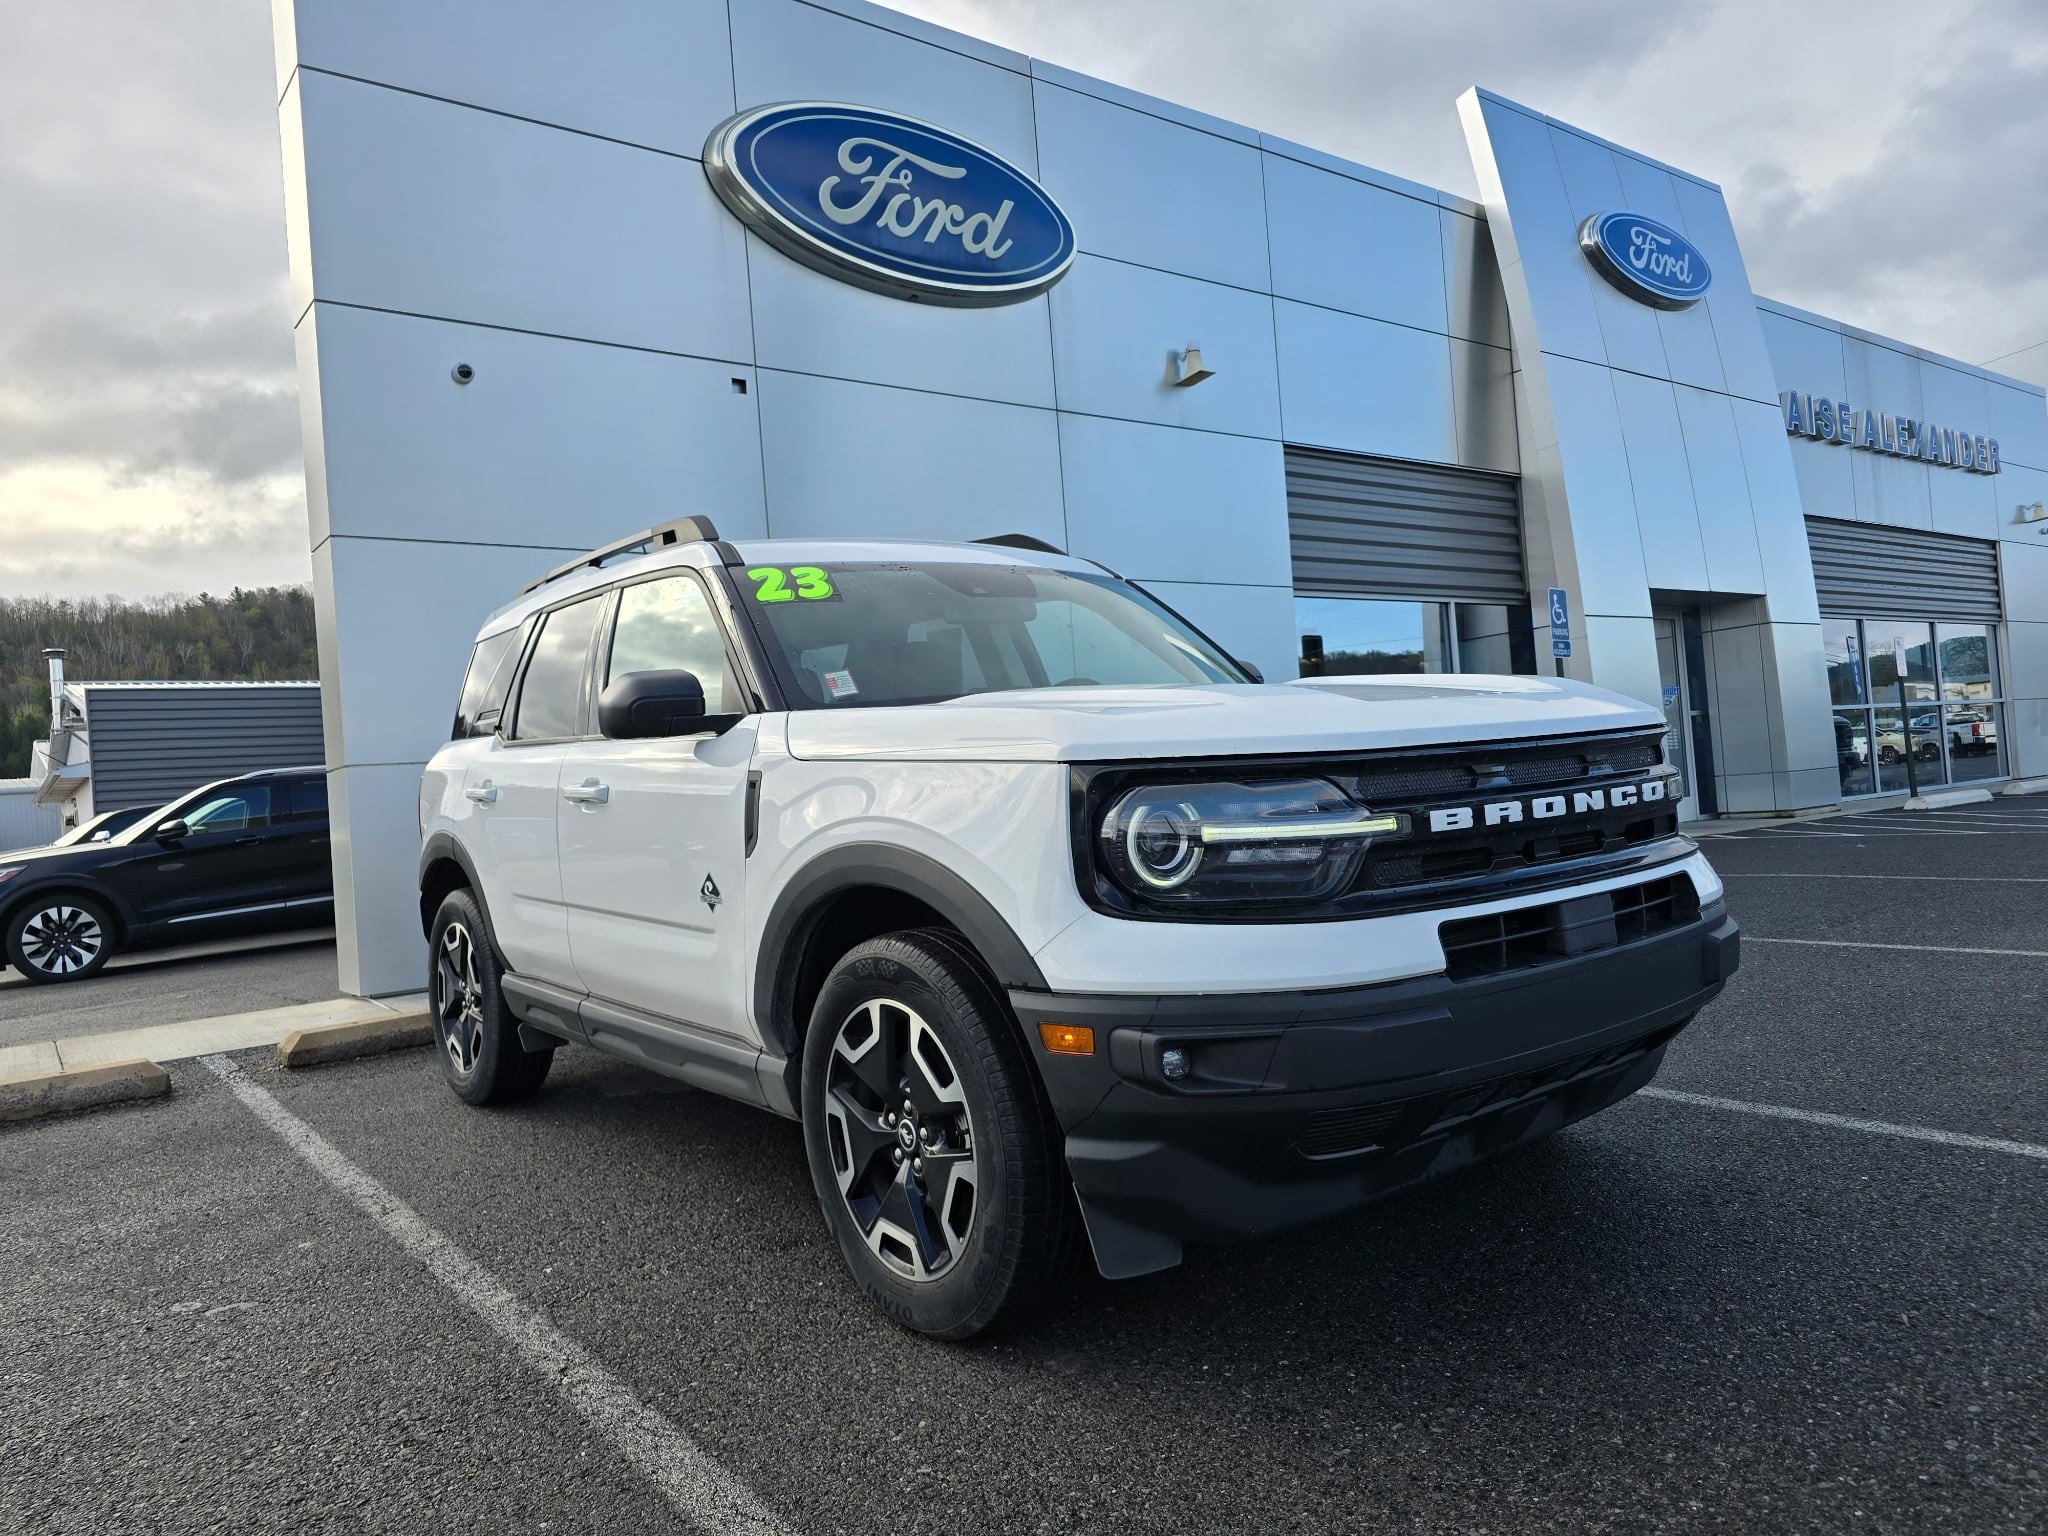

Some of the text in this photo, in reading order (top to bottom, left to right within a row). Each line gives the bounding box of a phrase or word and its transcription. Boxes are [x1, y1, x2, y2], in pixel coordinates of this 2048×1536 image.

[819, 137, 1015, 260] Ford
[1629, 226, 1693, 284] Ford
[1781, 390, 2001, 473] AISE ALEXANDER
[747, 566, 833, 602] 23
[1430, 780, 1664, 832] BRONCO
